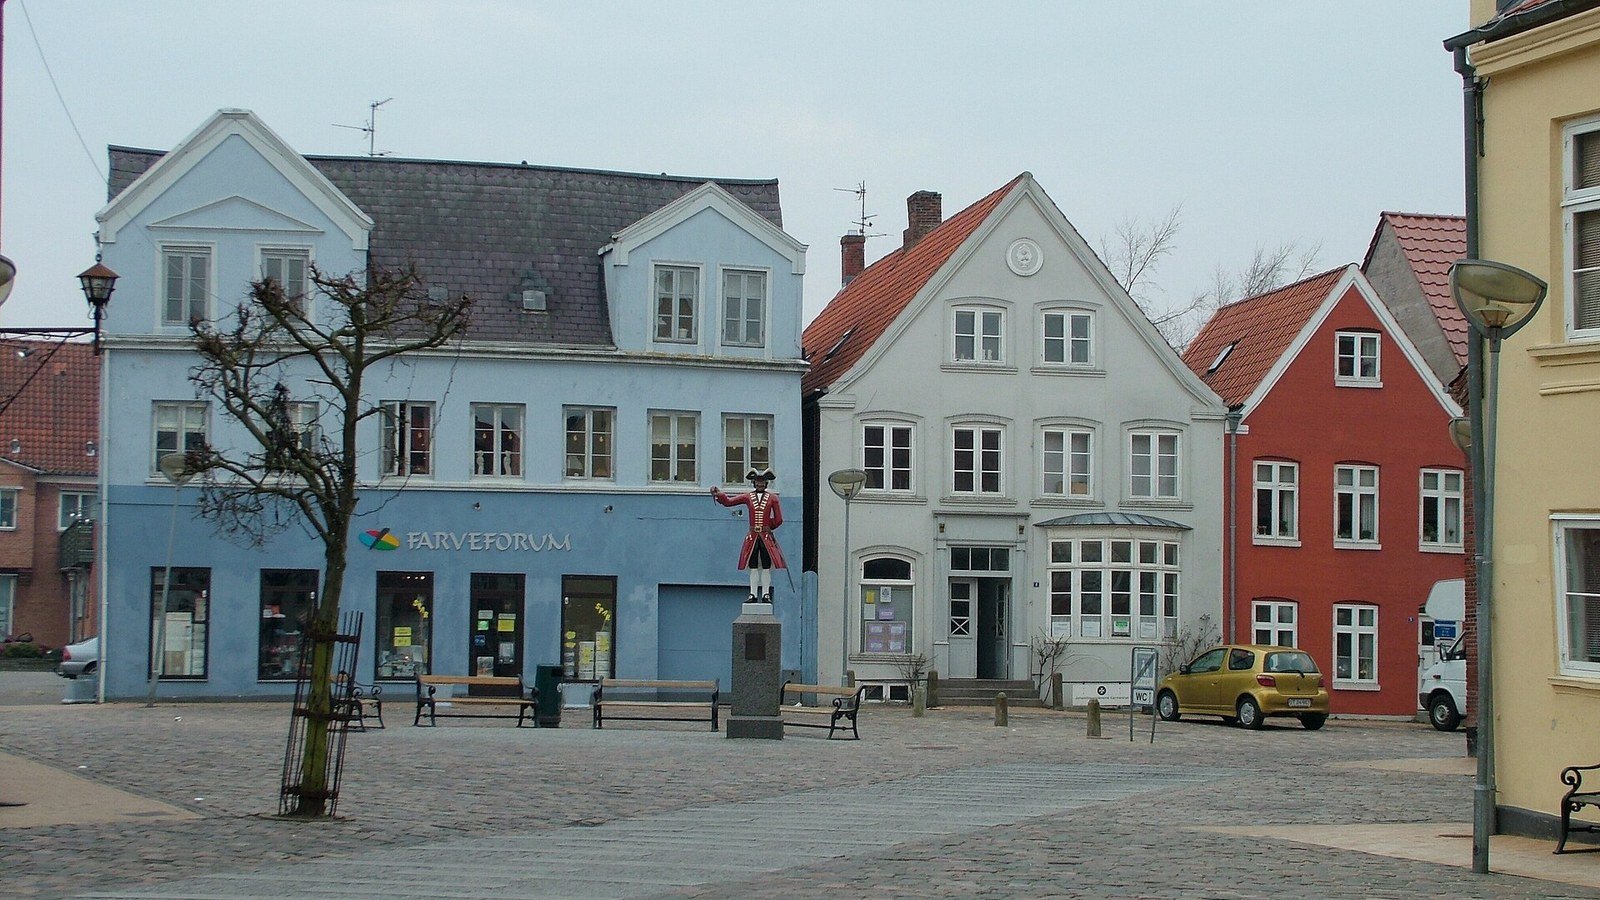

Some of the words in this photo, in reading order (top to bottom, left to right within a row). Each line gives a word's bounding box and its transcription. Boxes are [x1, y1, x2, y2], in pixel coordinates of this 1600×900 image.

[407, 531, 572, 552] FARVEFORUM
[594, 602, 611, 622] SPAR
[1135, 692, 1148, 702] WC
